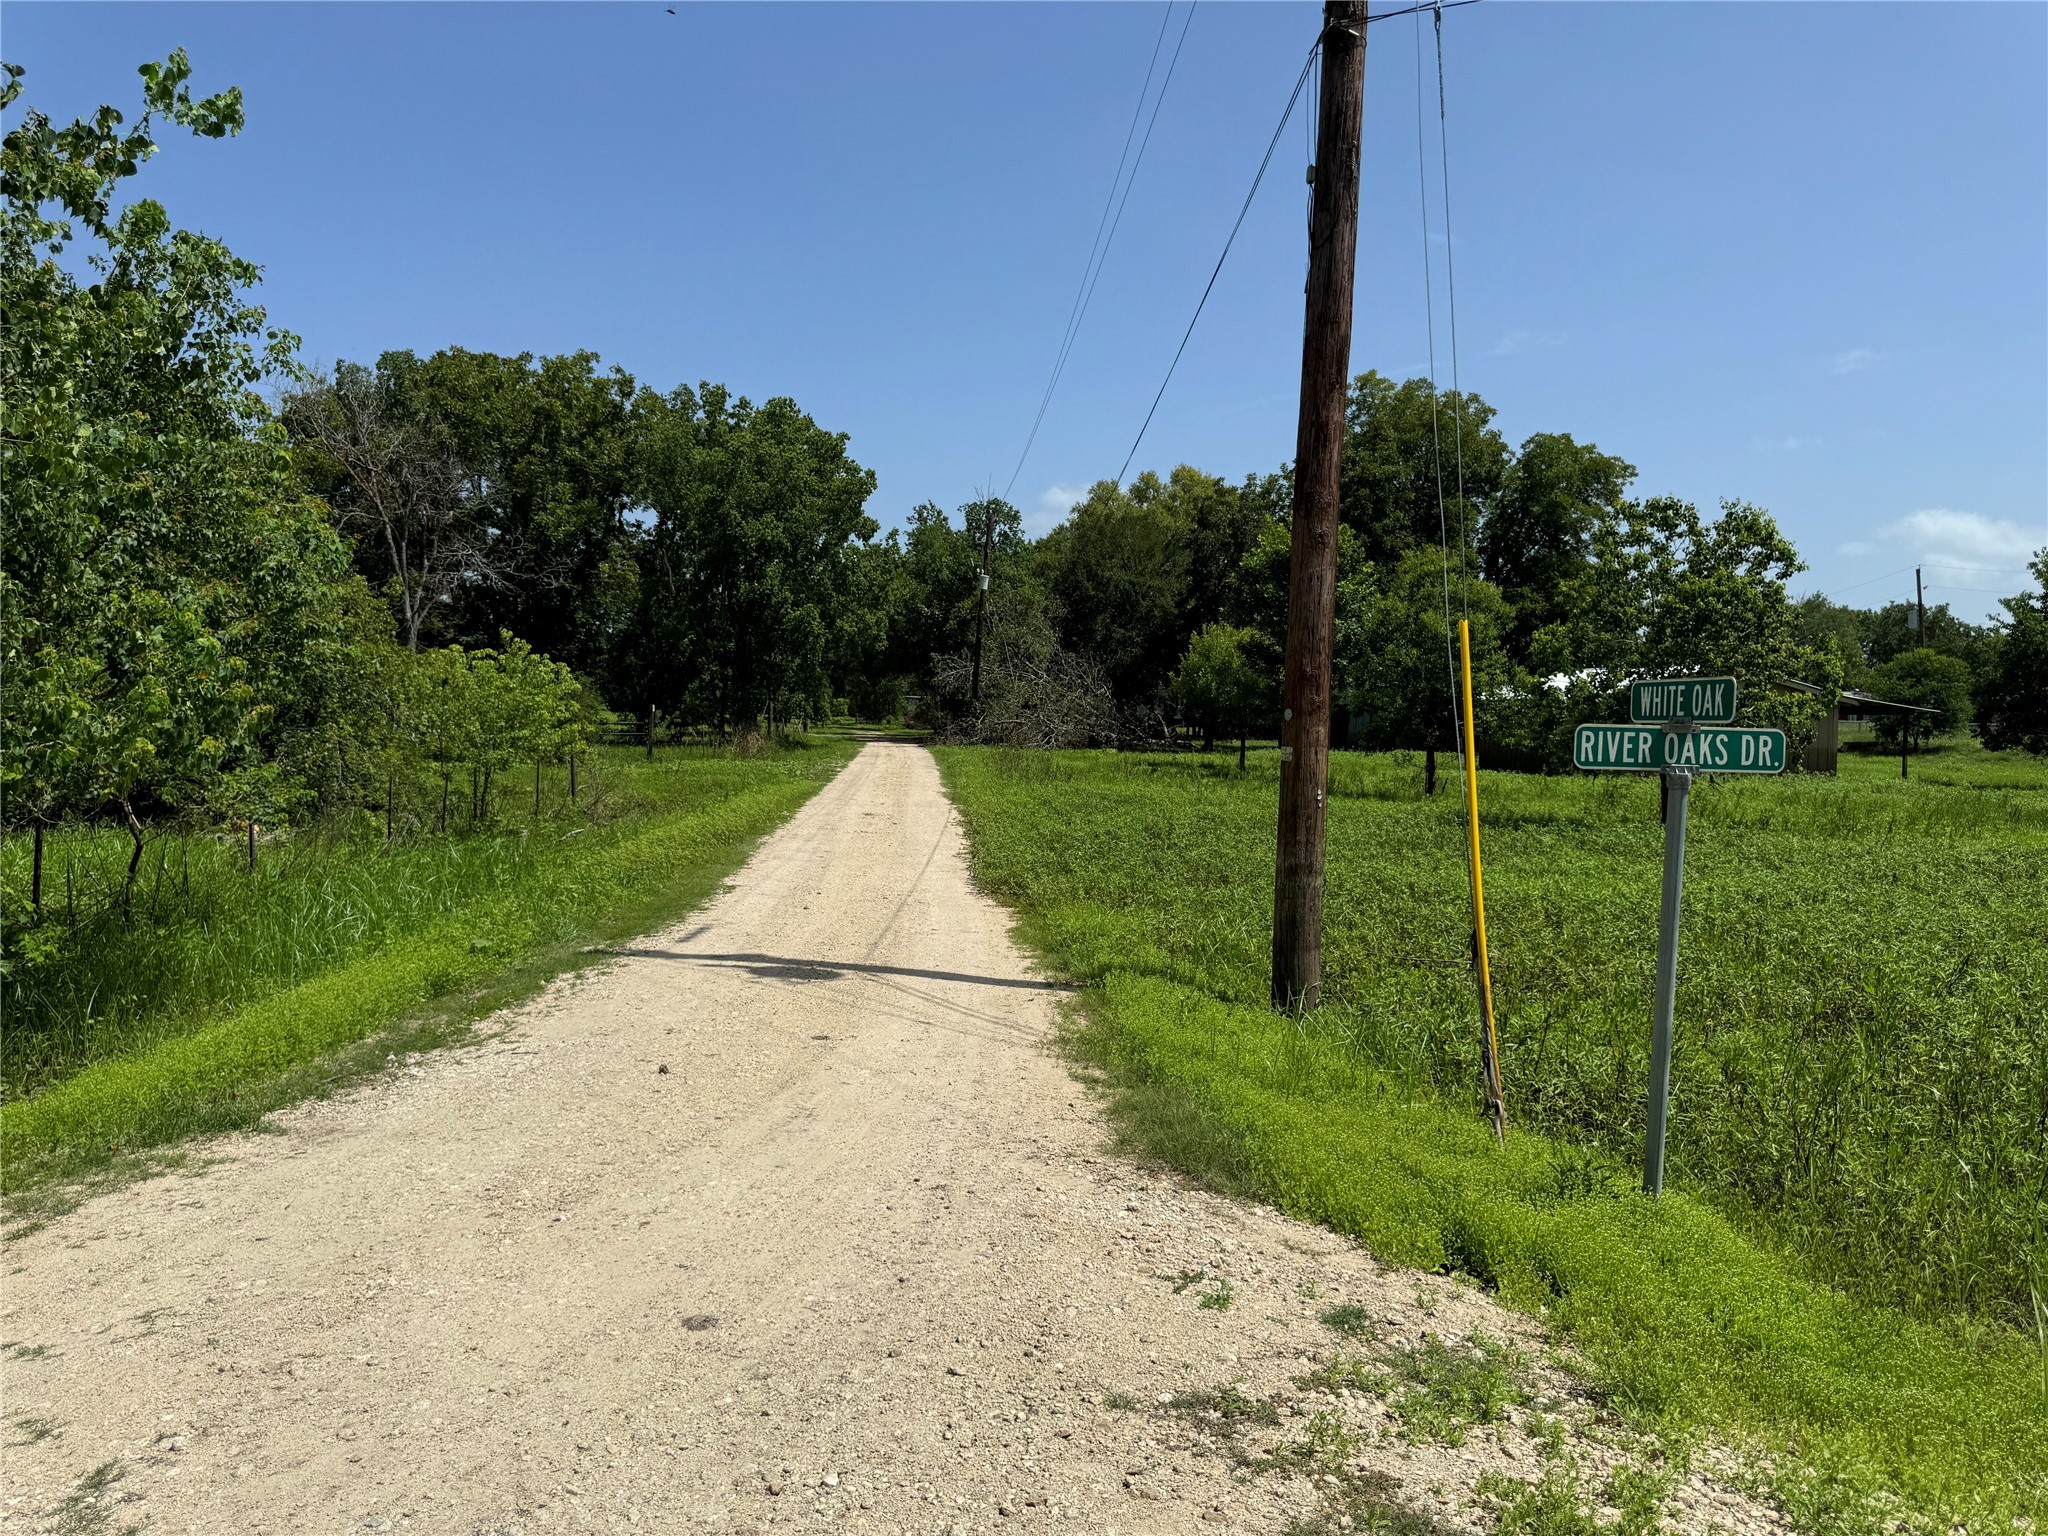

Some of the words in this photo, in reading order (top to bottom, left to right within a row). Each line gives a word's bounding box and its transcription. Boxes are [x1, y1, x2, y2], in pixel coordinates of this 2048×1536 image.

[1640, 684, 1686, 717] WHITE
[1692, 683, 1725, 716] OAK
[1580, 730, 1652, 763] RIVER
[1664, 732, 1729, 765] OAKS
[1741, 734, 1780, 767] DR.
